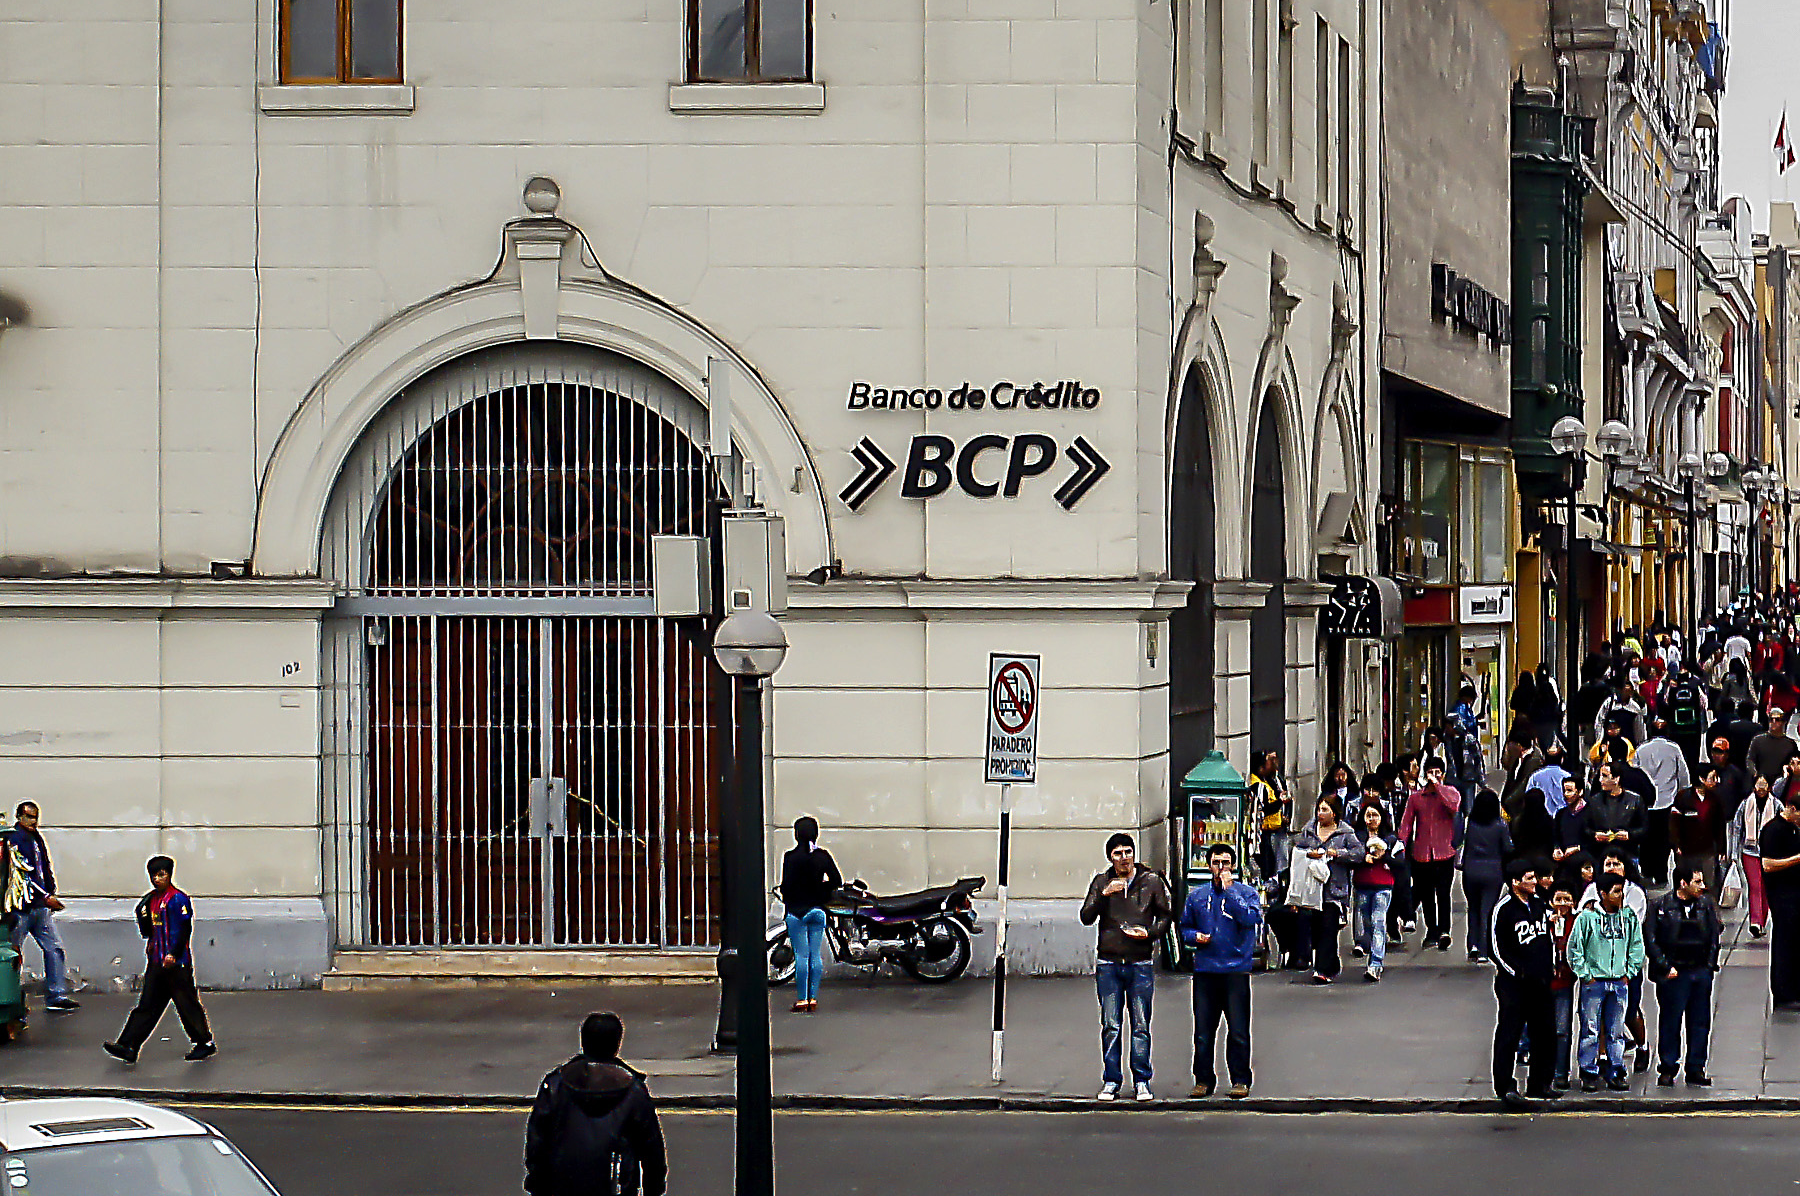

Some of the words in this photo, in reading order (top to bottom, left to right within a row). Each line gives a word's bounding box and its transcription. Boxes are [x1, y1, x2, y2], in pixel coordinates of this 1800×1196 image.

[847, 381, 943, 410] Banco
[947, 381, 986, 410] de
[989, 380, 1102, 410] Crédito
[900, 434, 1058, 500] BCP
[991, 735, 1032, 754] PARADERO
